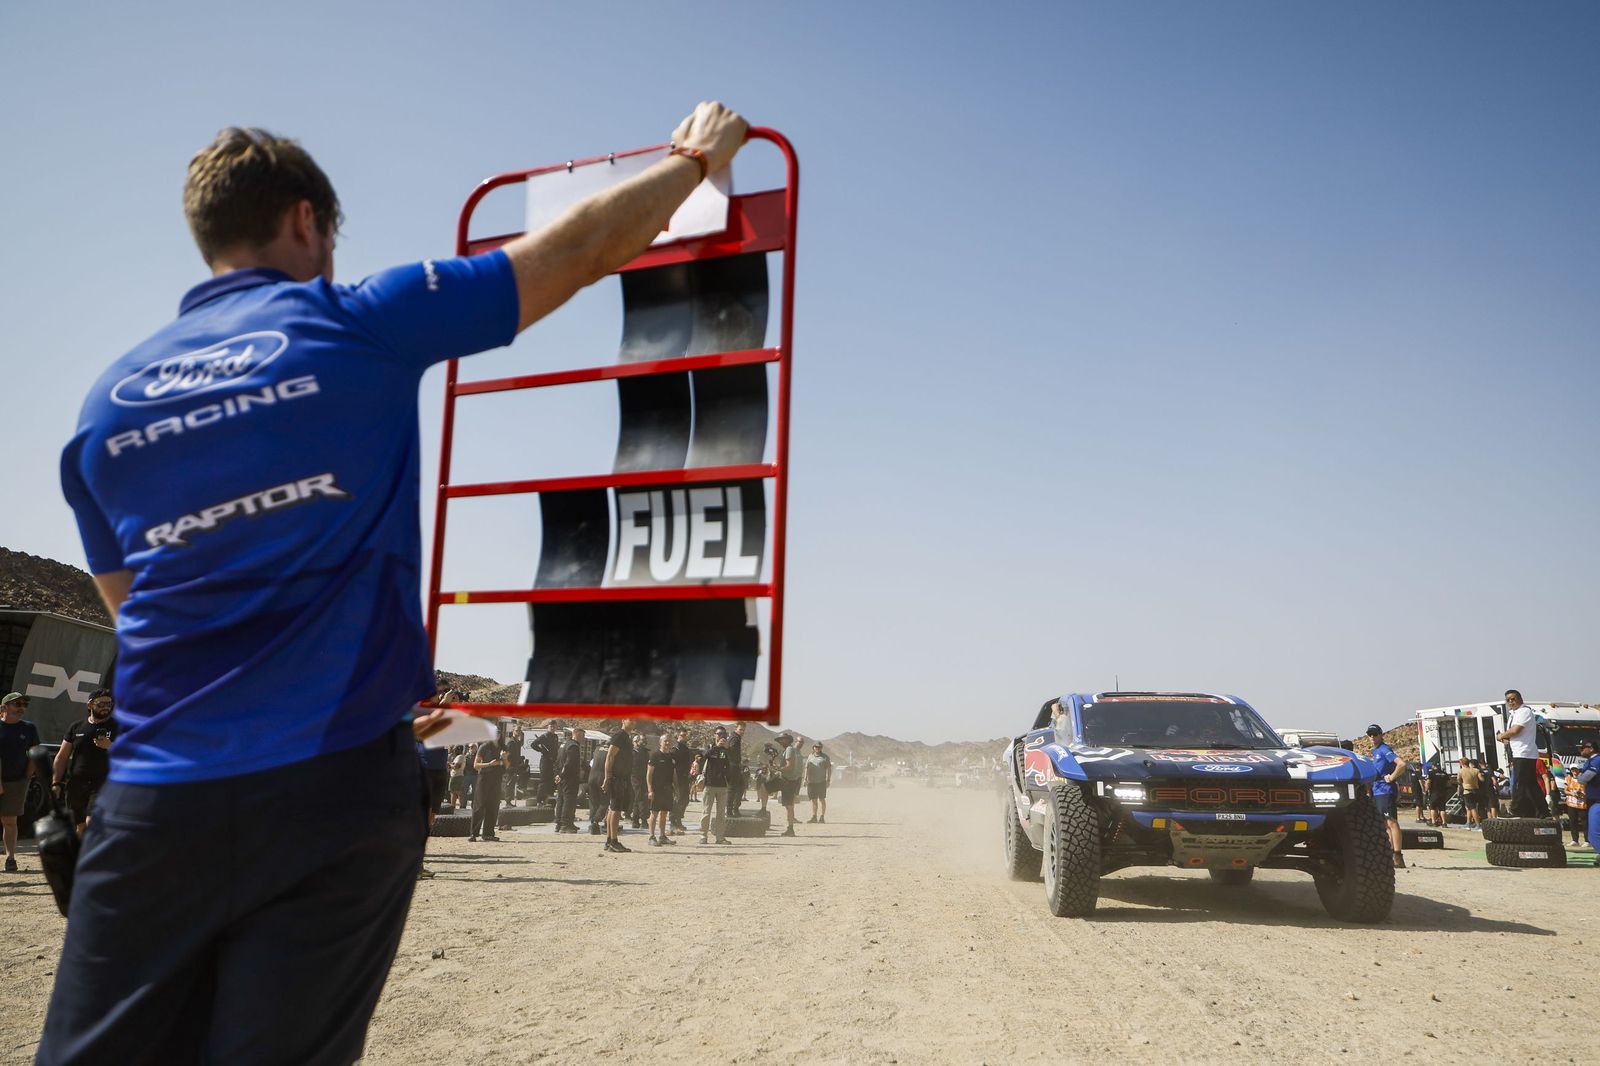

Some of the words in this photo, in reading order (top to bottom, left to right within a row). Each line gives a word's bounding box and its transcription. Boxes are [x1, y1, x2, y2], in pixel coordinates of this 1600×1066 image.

[144, 344, 256, 398] Ford
[105, 375, 322, 458] RACING
[145, 472, 351, 547] RAPTOR
[613, 486, 760, 582] FUEL
[1150, 787, 1307, 804] FORD
